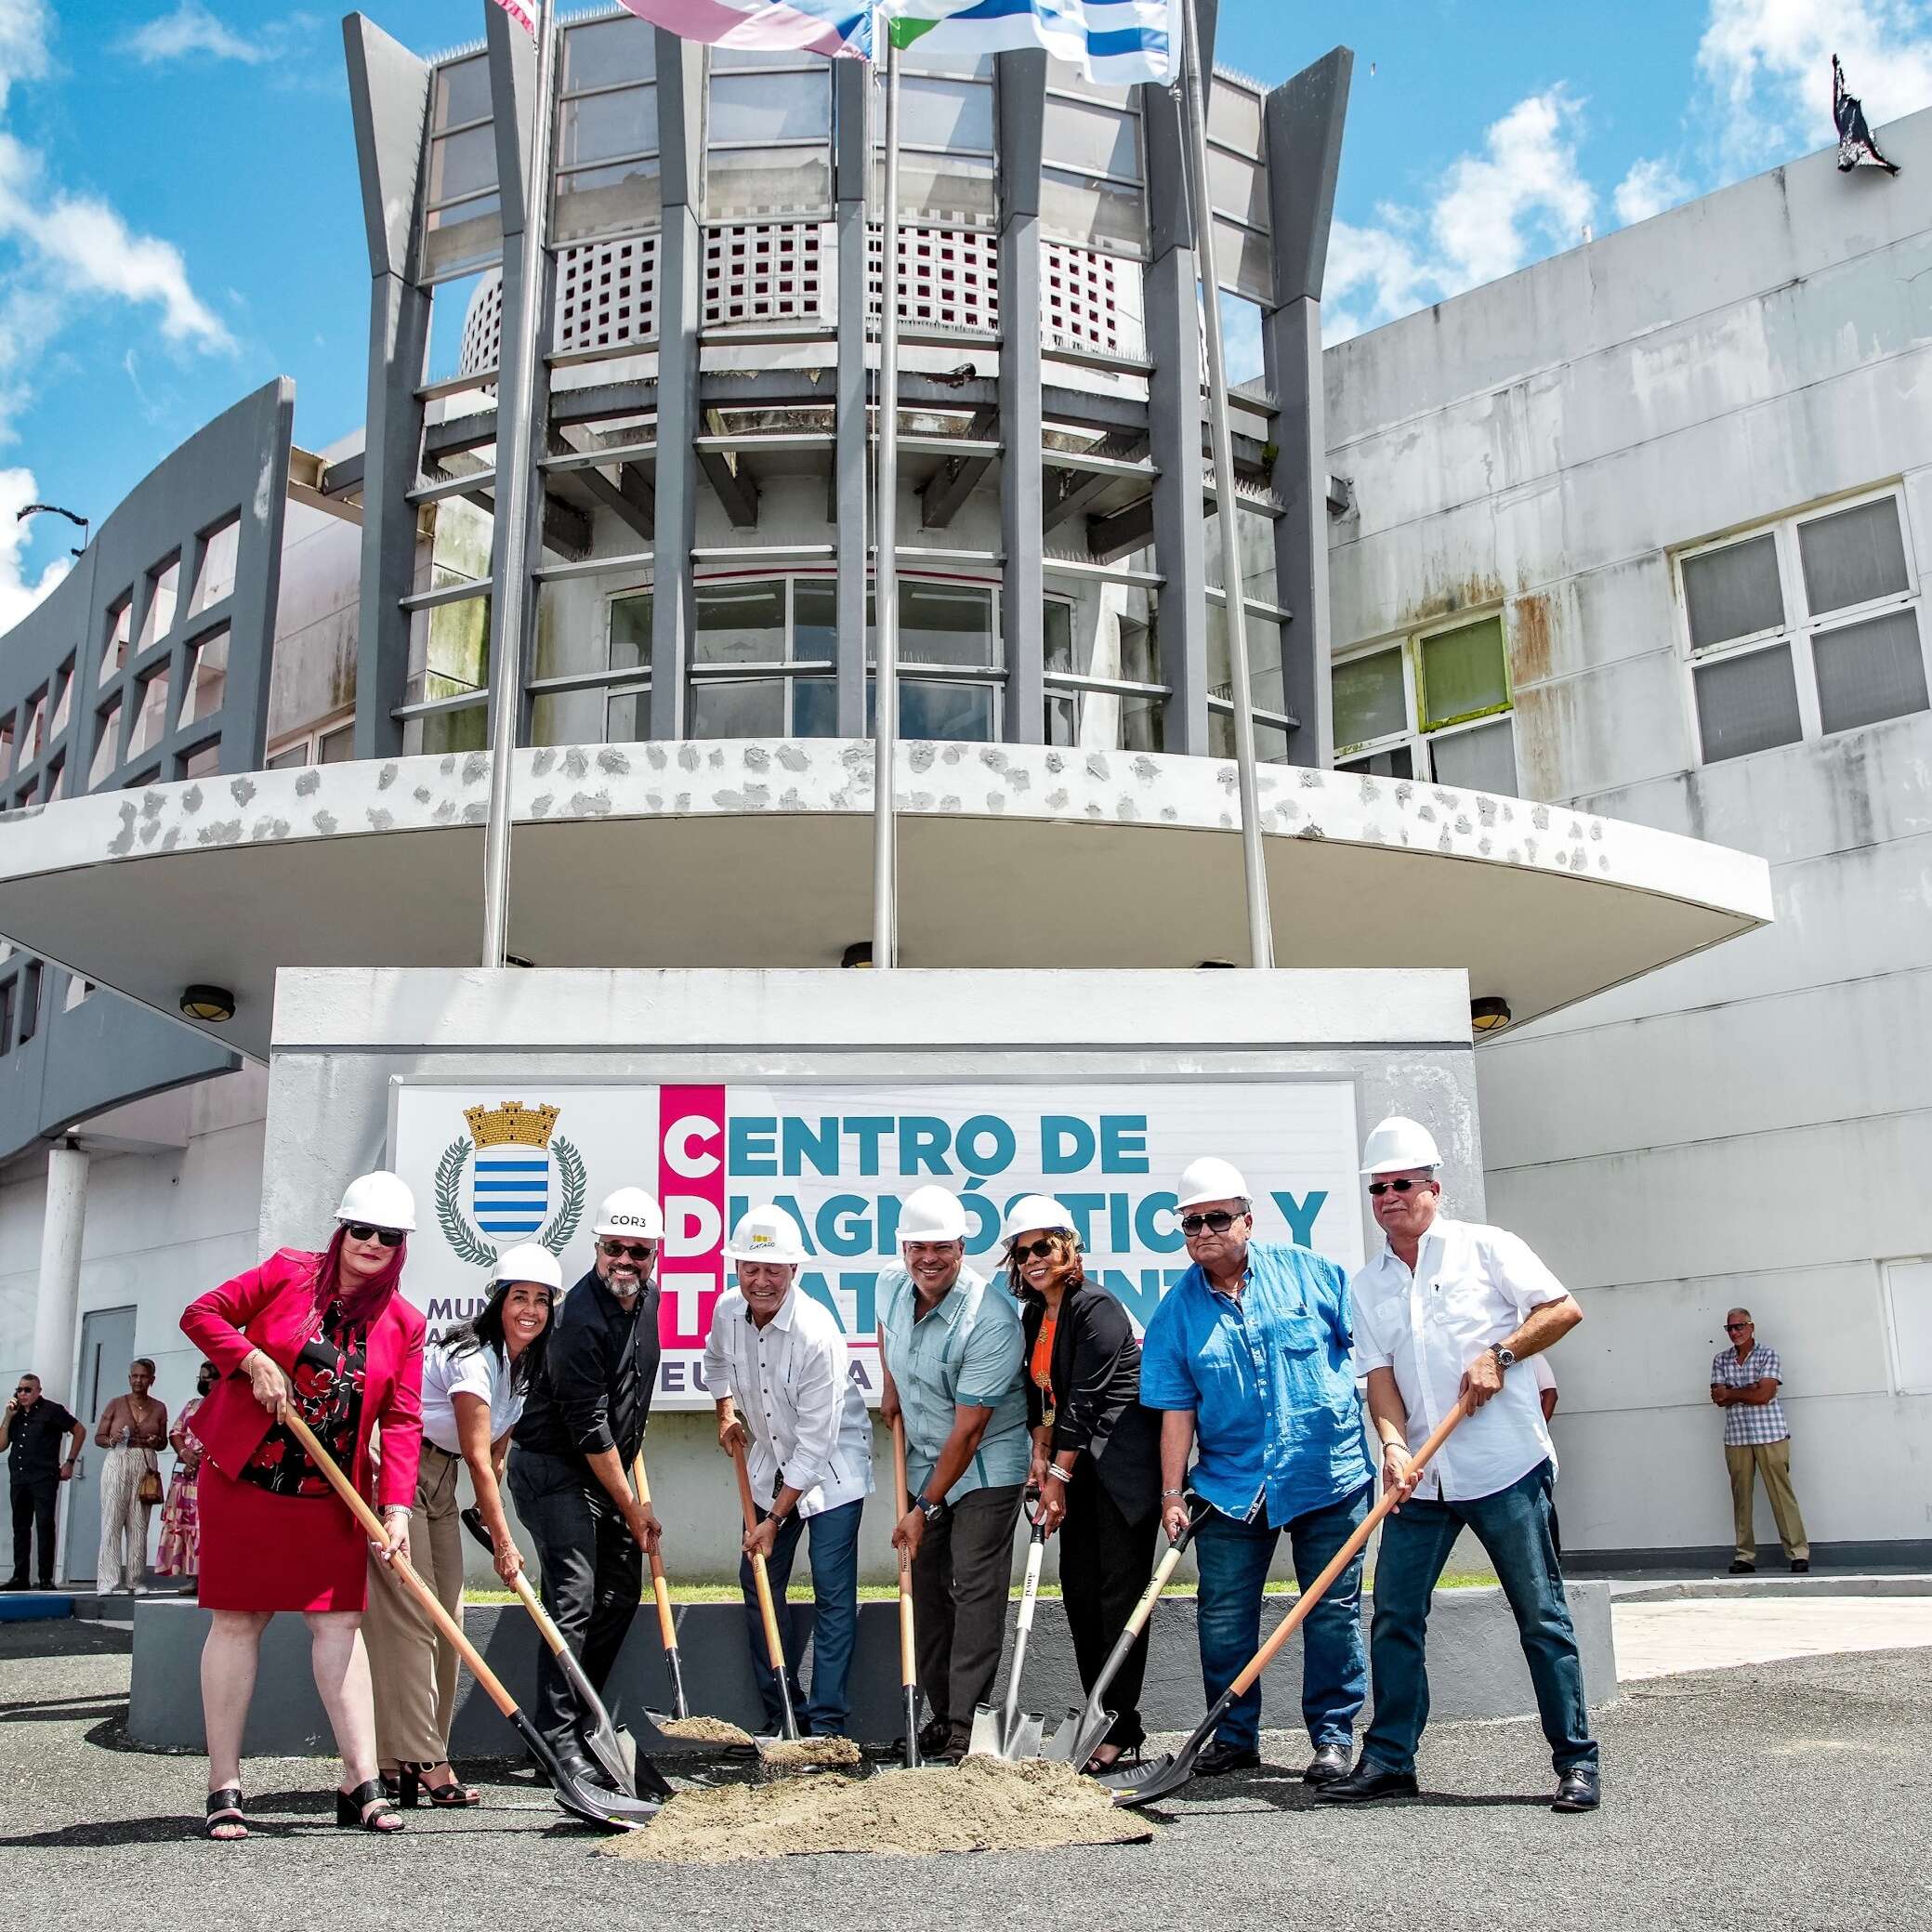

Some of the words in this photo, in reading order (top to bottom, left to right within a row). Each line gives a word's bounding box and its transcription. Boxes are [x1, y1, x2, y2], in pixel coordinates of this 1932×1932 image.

[664, 1114, 1017, 1178] CENTRO
[1040, 1114, 1150, 1175] DE
[611, 1215, 646, 1228] COR3
[1269, 1190, 1329, 1249] Y
